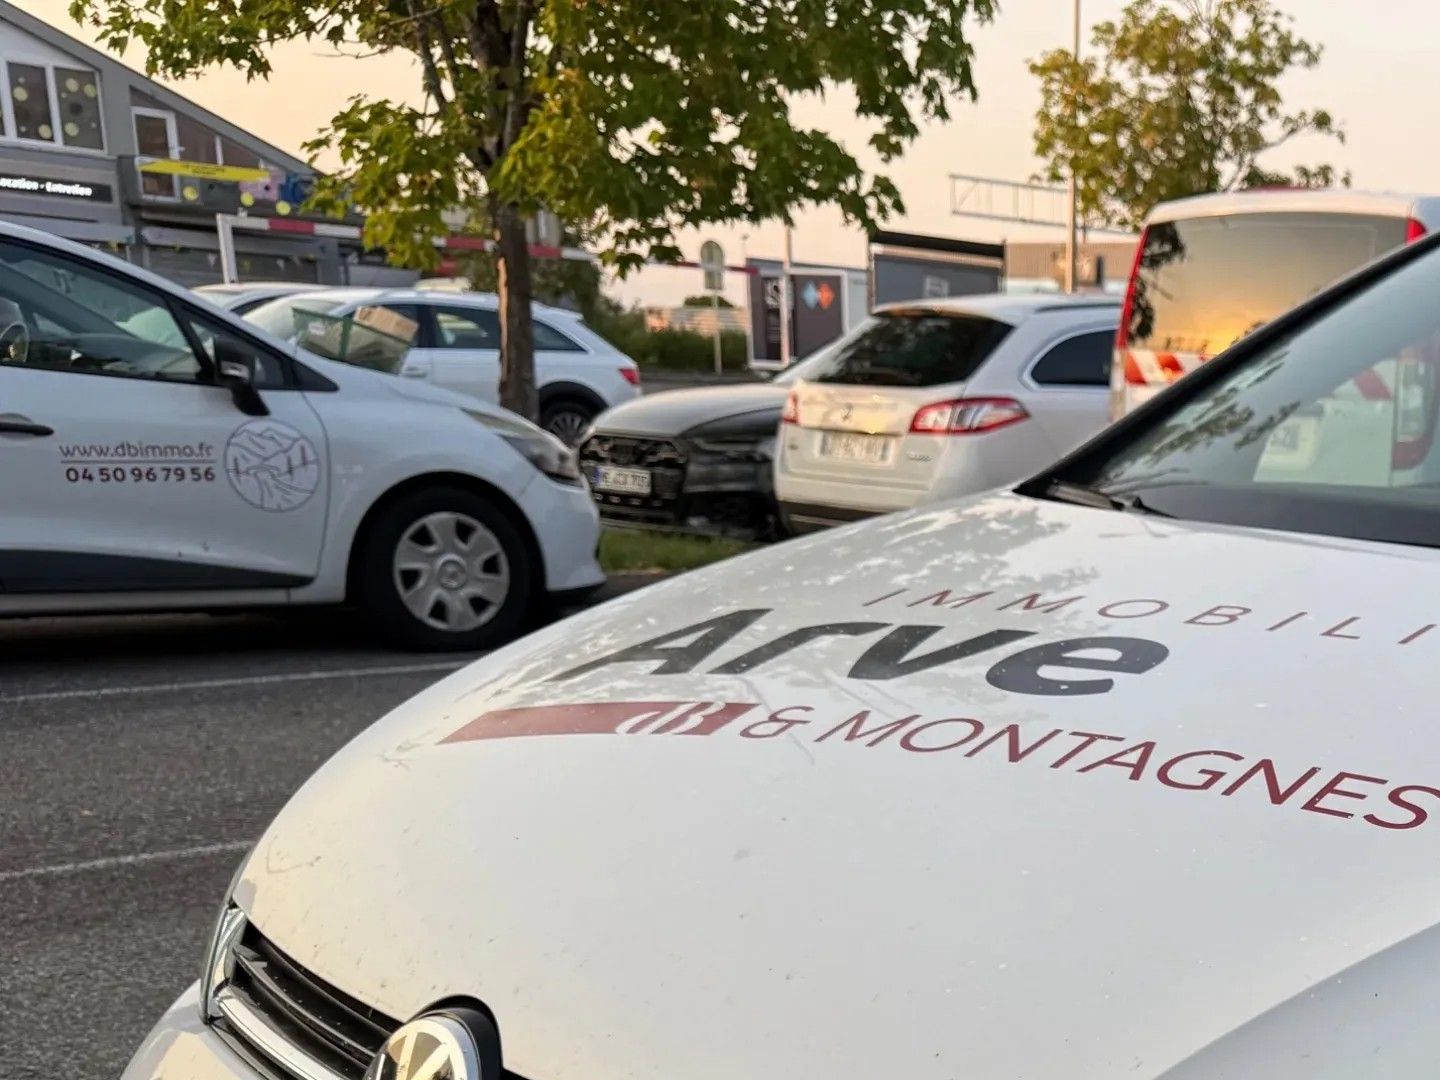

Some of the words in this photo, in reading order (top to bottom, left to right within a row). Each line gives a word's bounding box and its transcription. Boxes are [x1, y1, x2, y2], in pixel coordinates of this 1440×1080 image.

[59, 441, 214, 458] www.dbimmo.fr
[544, 608, 1171, 696] Arve
[739, 705, 815, 739] &
